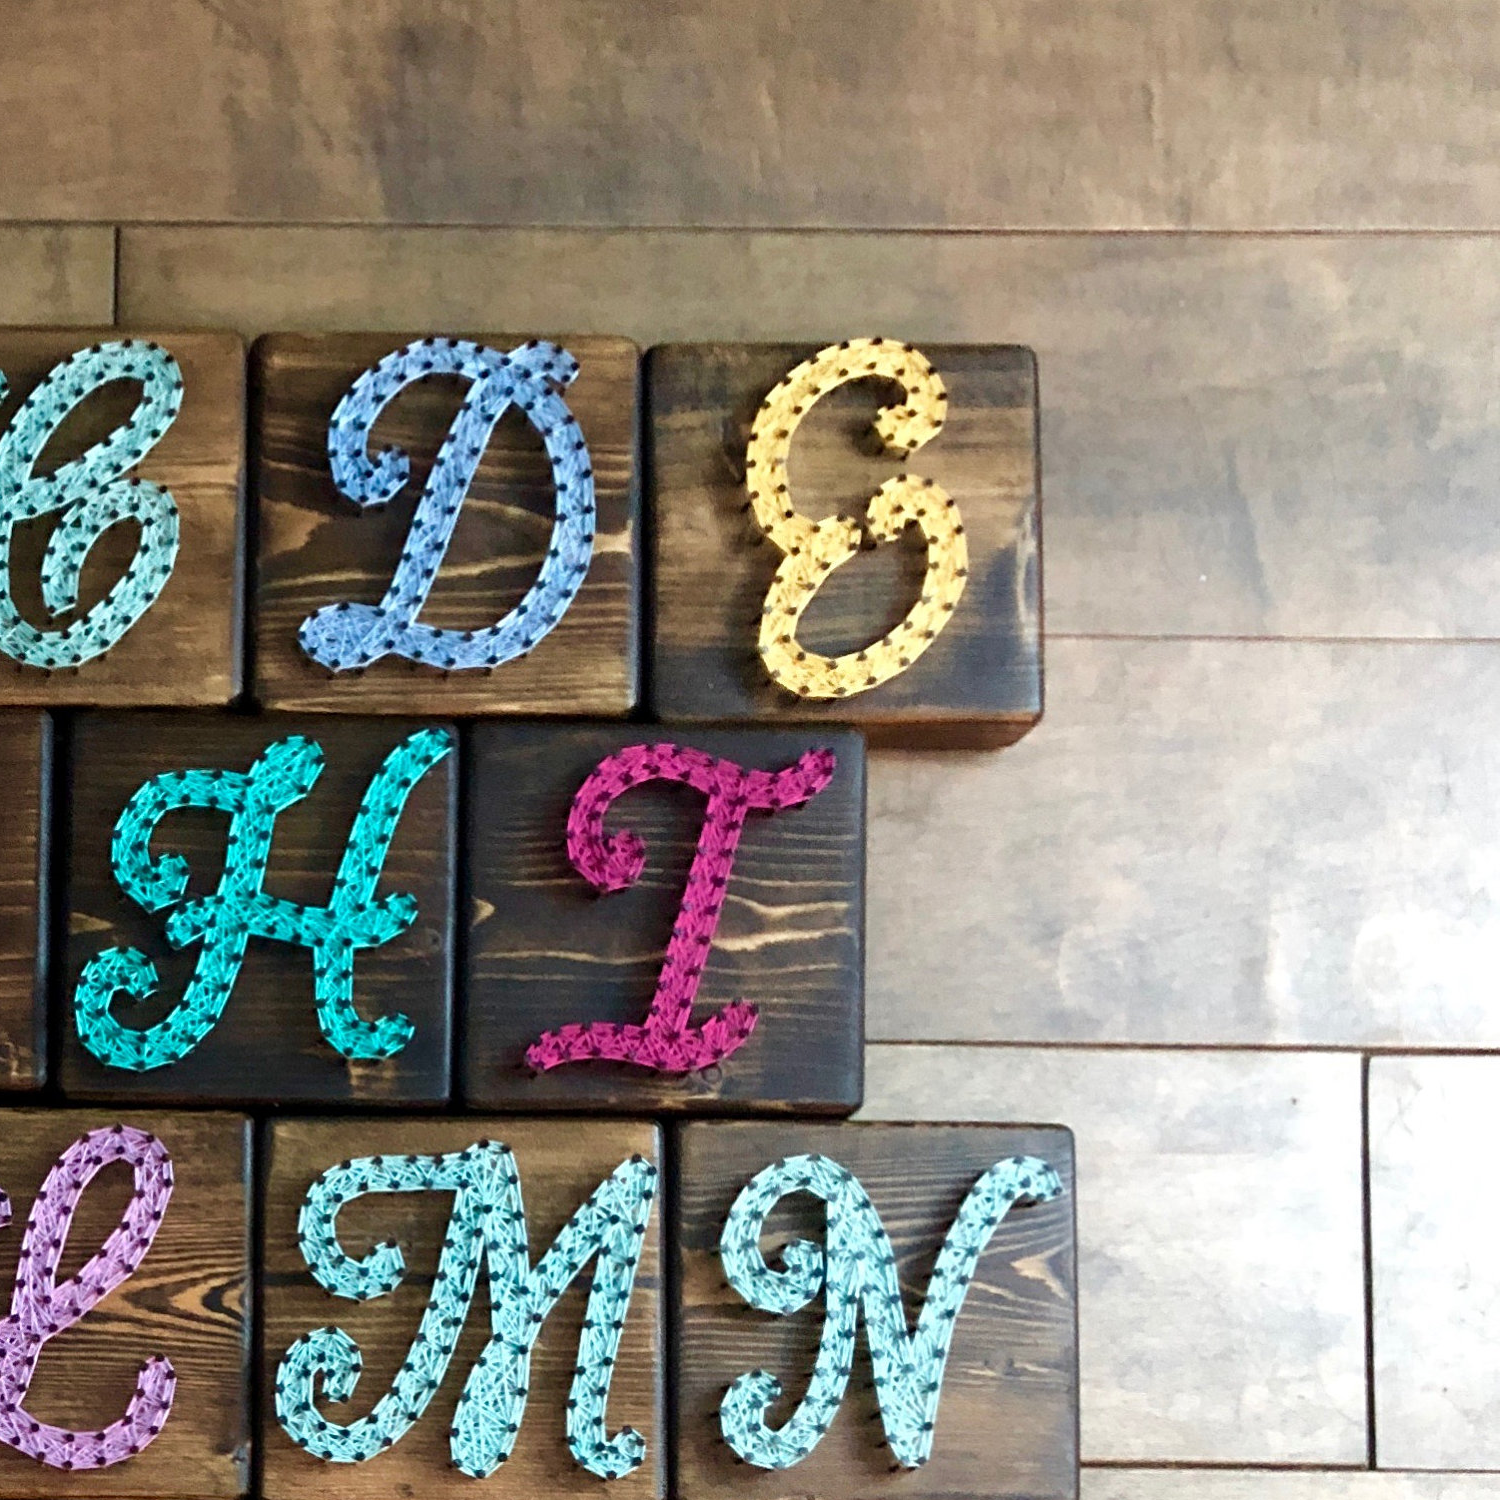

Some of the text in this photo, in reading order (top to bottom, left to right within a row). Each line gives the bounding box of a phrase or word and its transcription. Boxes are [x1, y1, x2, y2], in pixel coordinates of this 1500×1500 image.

[300, 339, 595, 670] D
[747, 338, 969, 697] E
[75, 730, 450, 1069] H
[528, 744, 834, 1071] I
[276, 1141, 658, 1478] M
[721, 1154, 1063, 1469] N
